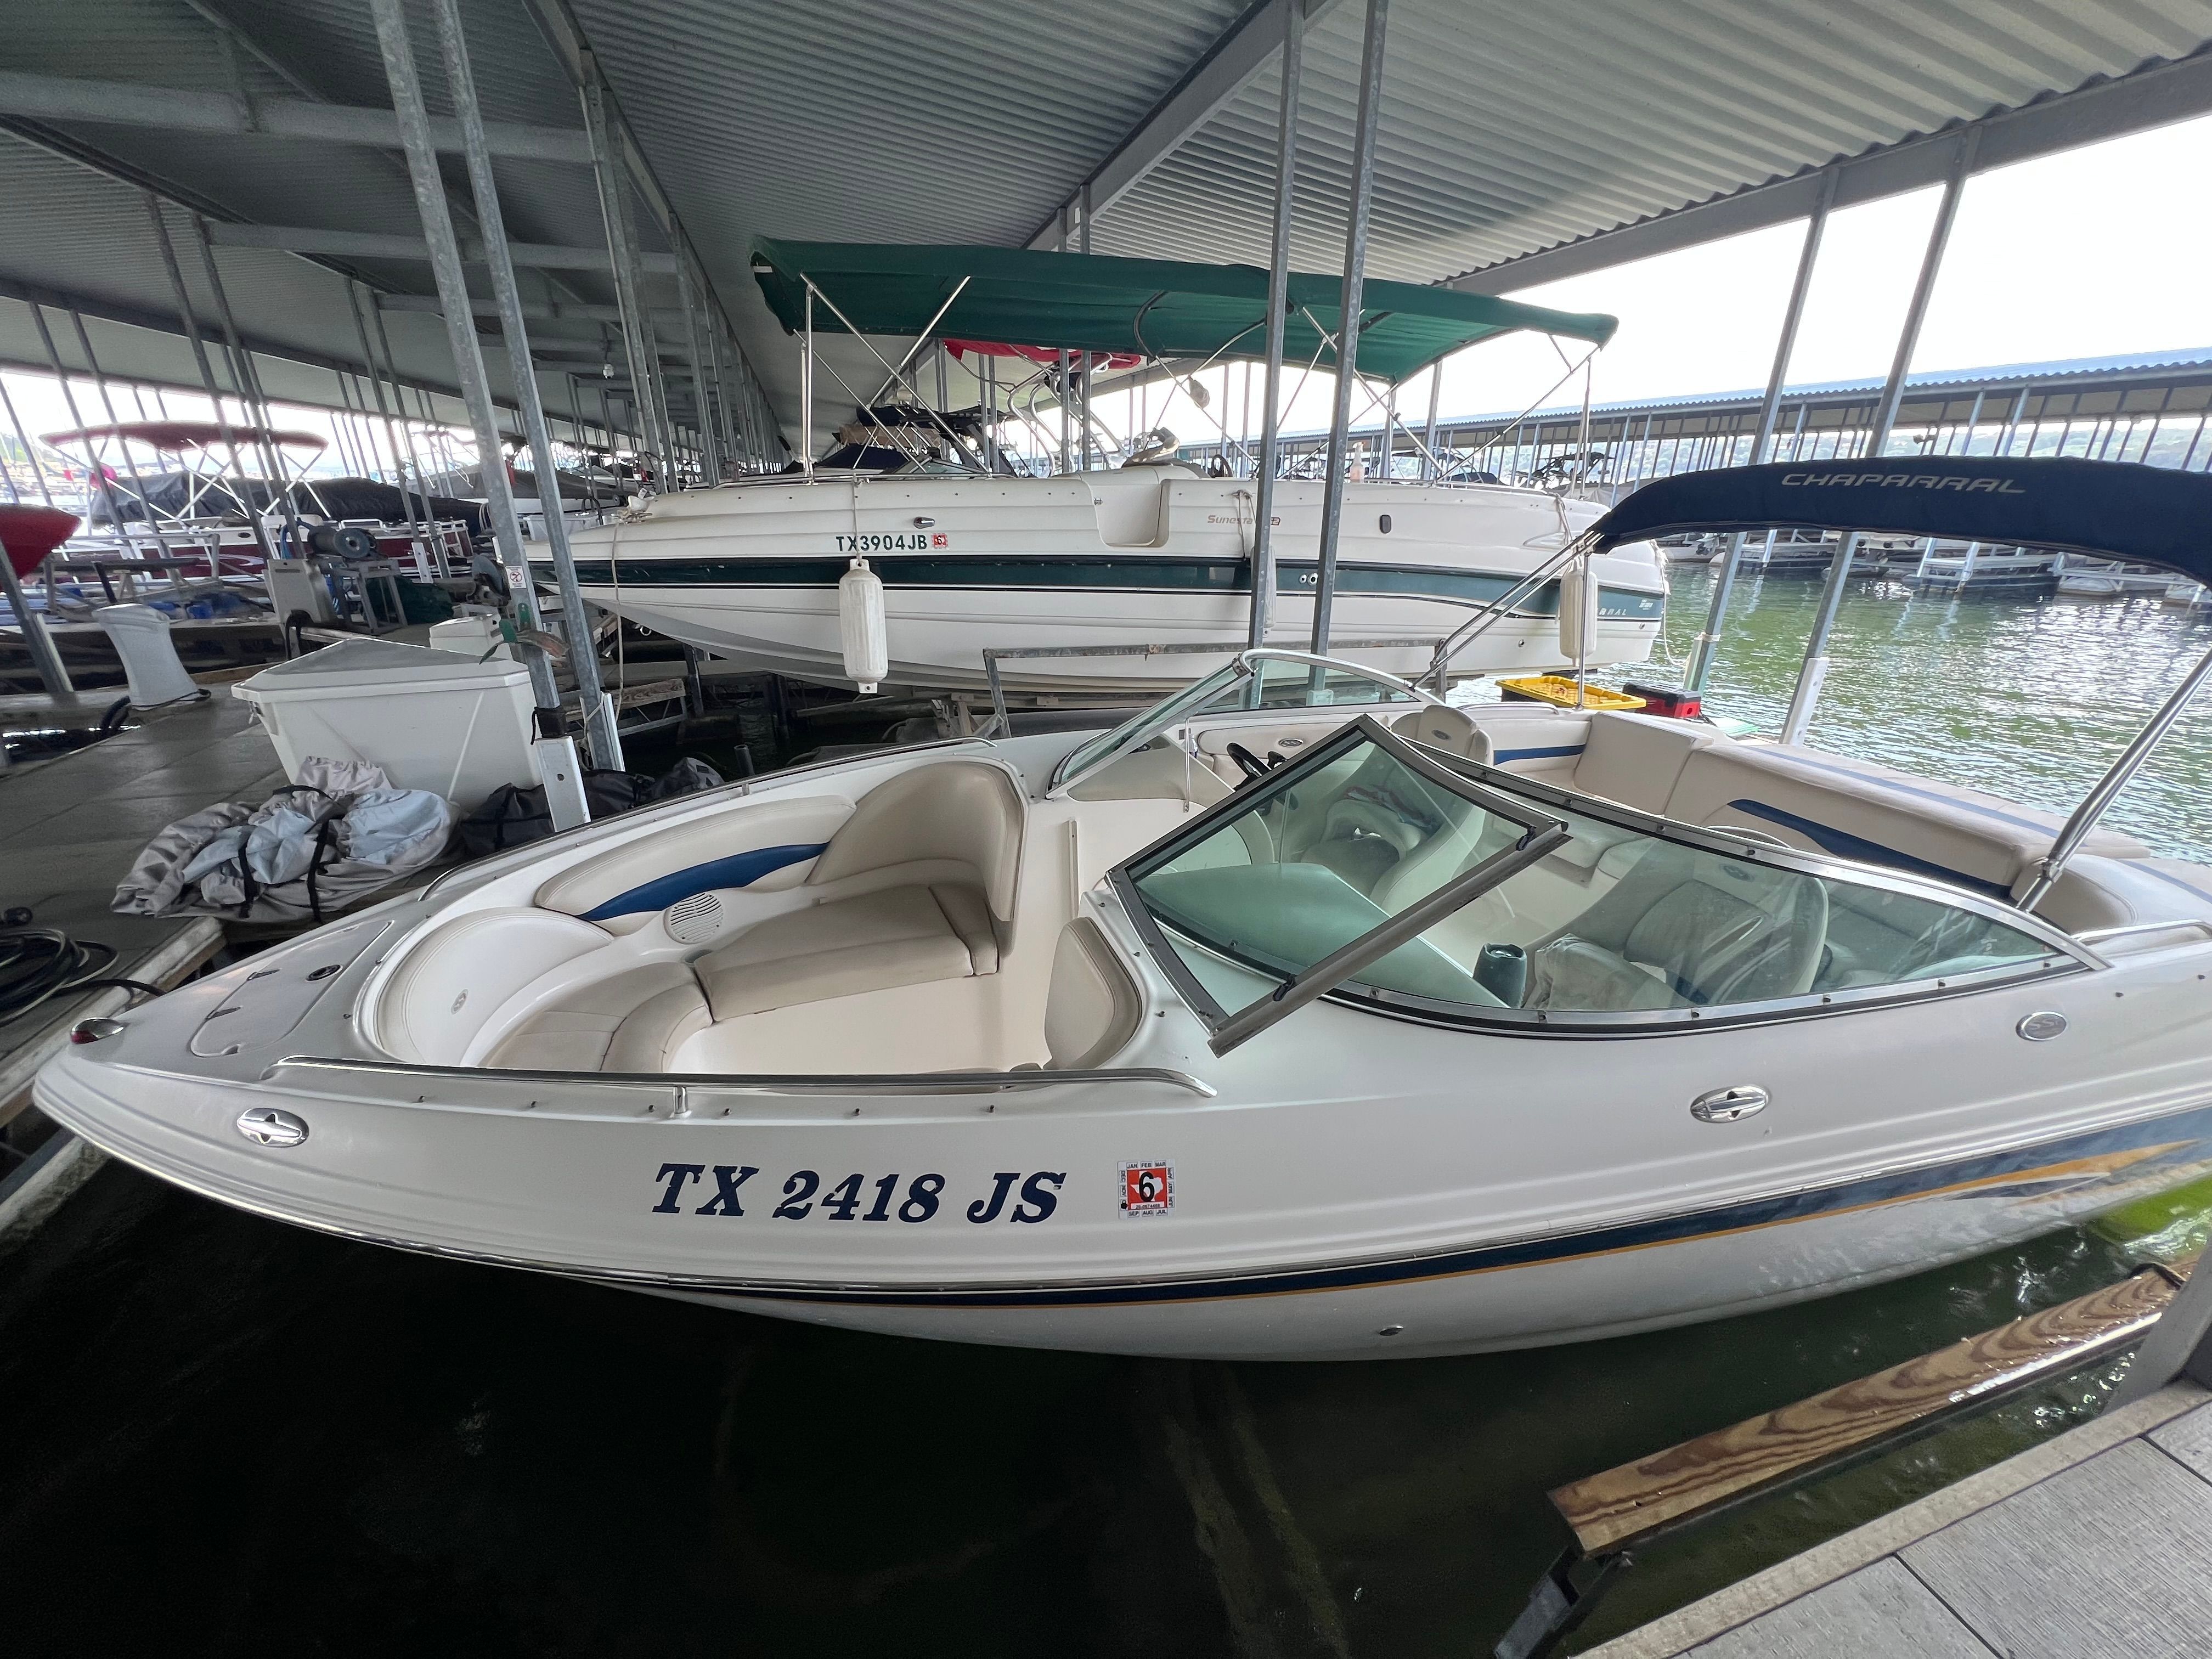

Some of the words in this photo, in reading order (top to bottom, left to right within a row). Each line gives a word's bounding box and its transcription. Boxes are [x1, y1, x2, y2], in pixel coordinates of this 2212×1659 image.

[1781, 473, 2027, 494] CHAPARRAL
[1207, 515, 1253, 524] Sunesta
[836, 534, 928, 551] TX3904JB
[652, 1163, 759, 1217] TX
[772, 1170, 946, 1222] 2418
[967, 1171, 1067, 1223] JS
[1138, 1171, 1155, 1203] 6
